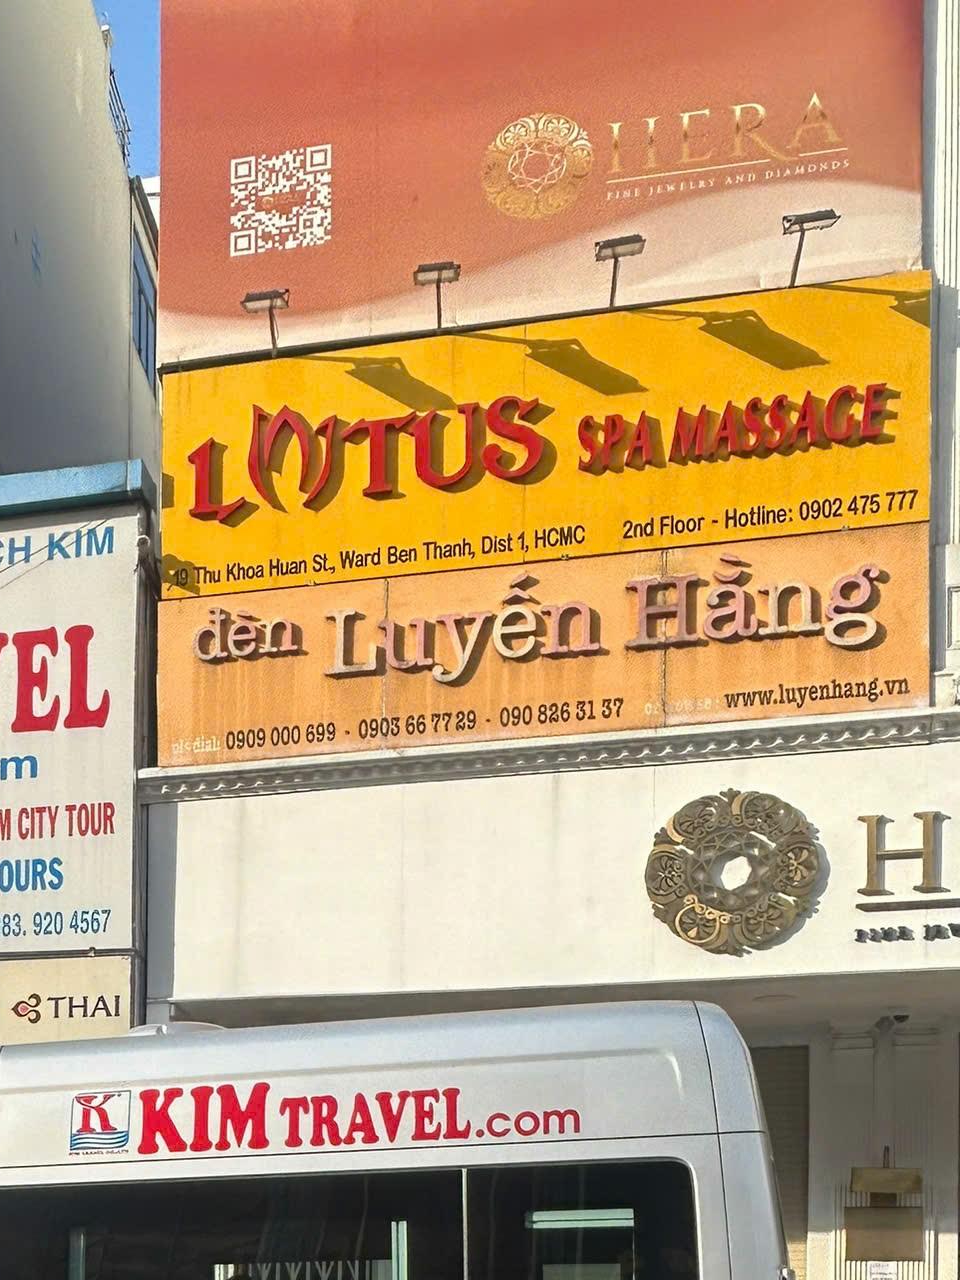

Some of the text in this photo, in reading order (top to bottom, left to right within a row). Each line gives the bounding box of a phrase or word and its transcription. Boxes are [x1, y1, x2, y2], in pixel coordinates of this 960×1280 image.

[648, 177, 716, 198] JEWELRY
[725, 173, 757, 187] AND
[765, 159, 851, 180] DIAMONDS
[578, 410, 653, 470] SPA
[669, 382, 888, 463] MASSAGE
[47, 525, 115, 562] KIM
[173, 568, 189, 587] 19
[193, 566, 221, 584] Thu
[226, 562, 265, 582] Khoa
[269, 557, 308, 578] Huan
[340, 548, 382, 569] Ward
[387, 545, 417, 564] Ben
[423, 537, 475, 561] Thanh,
[482, 533, 513, 556] Dist
[534, 524, 586, 549] HCMC
[623, 519, 654, 540] 2nd
[660, 515, 706, 537] Floor
[725, 506, 793, 530] Hotline:
[799, 498, 843, 522] 0902
[848, 494, 881, 517] 475
[886, 489, 919, 513] 777
[192, 553, 881, 684] đèn Luyến Hằng
[724, 677, 911, 710] www.luyenhang.vn
[226, 726, 266, 750] 0909
[270, 724, 301, 747] 000
[306, 721, 337, 744] 699
[358, 716, 401, 740] 0903
[405, 713, 427, 735] 66
[500, 706, 533, 727] 090
[537, 702, 571, 725] 826
[576, 699, 596, 721] 31
[601, 697, 624, 719] 37
[17, 805, 59, 840] CITY
[65, 801, 116, 837] TOUR
[33, 911, 64, 935] 920
[69, 909, 112, 934] 4567
[47, 994, 121, 1019] THAI
[137, 1081, 273, 1156] KIM
